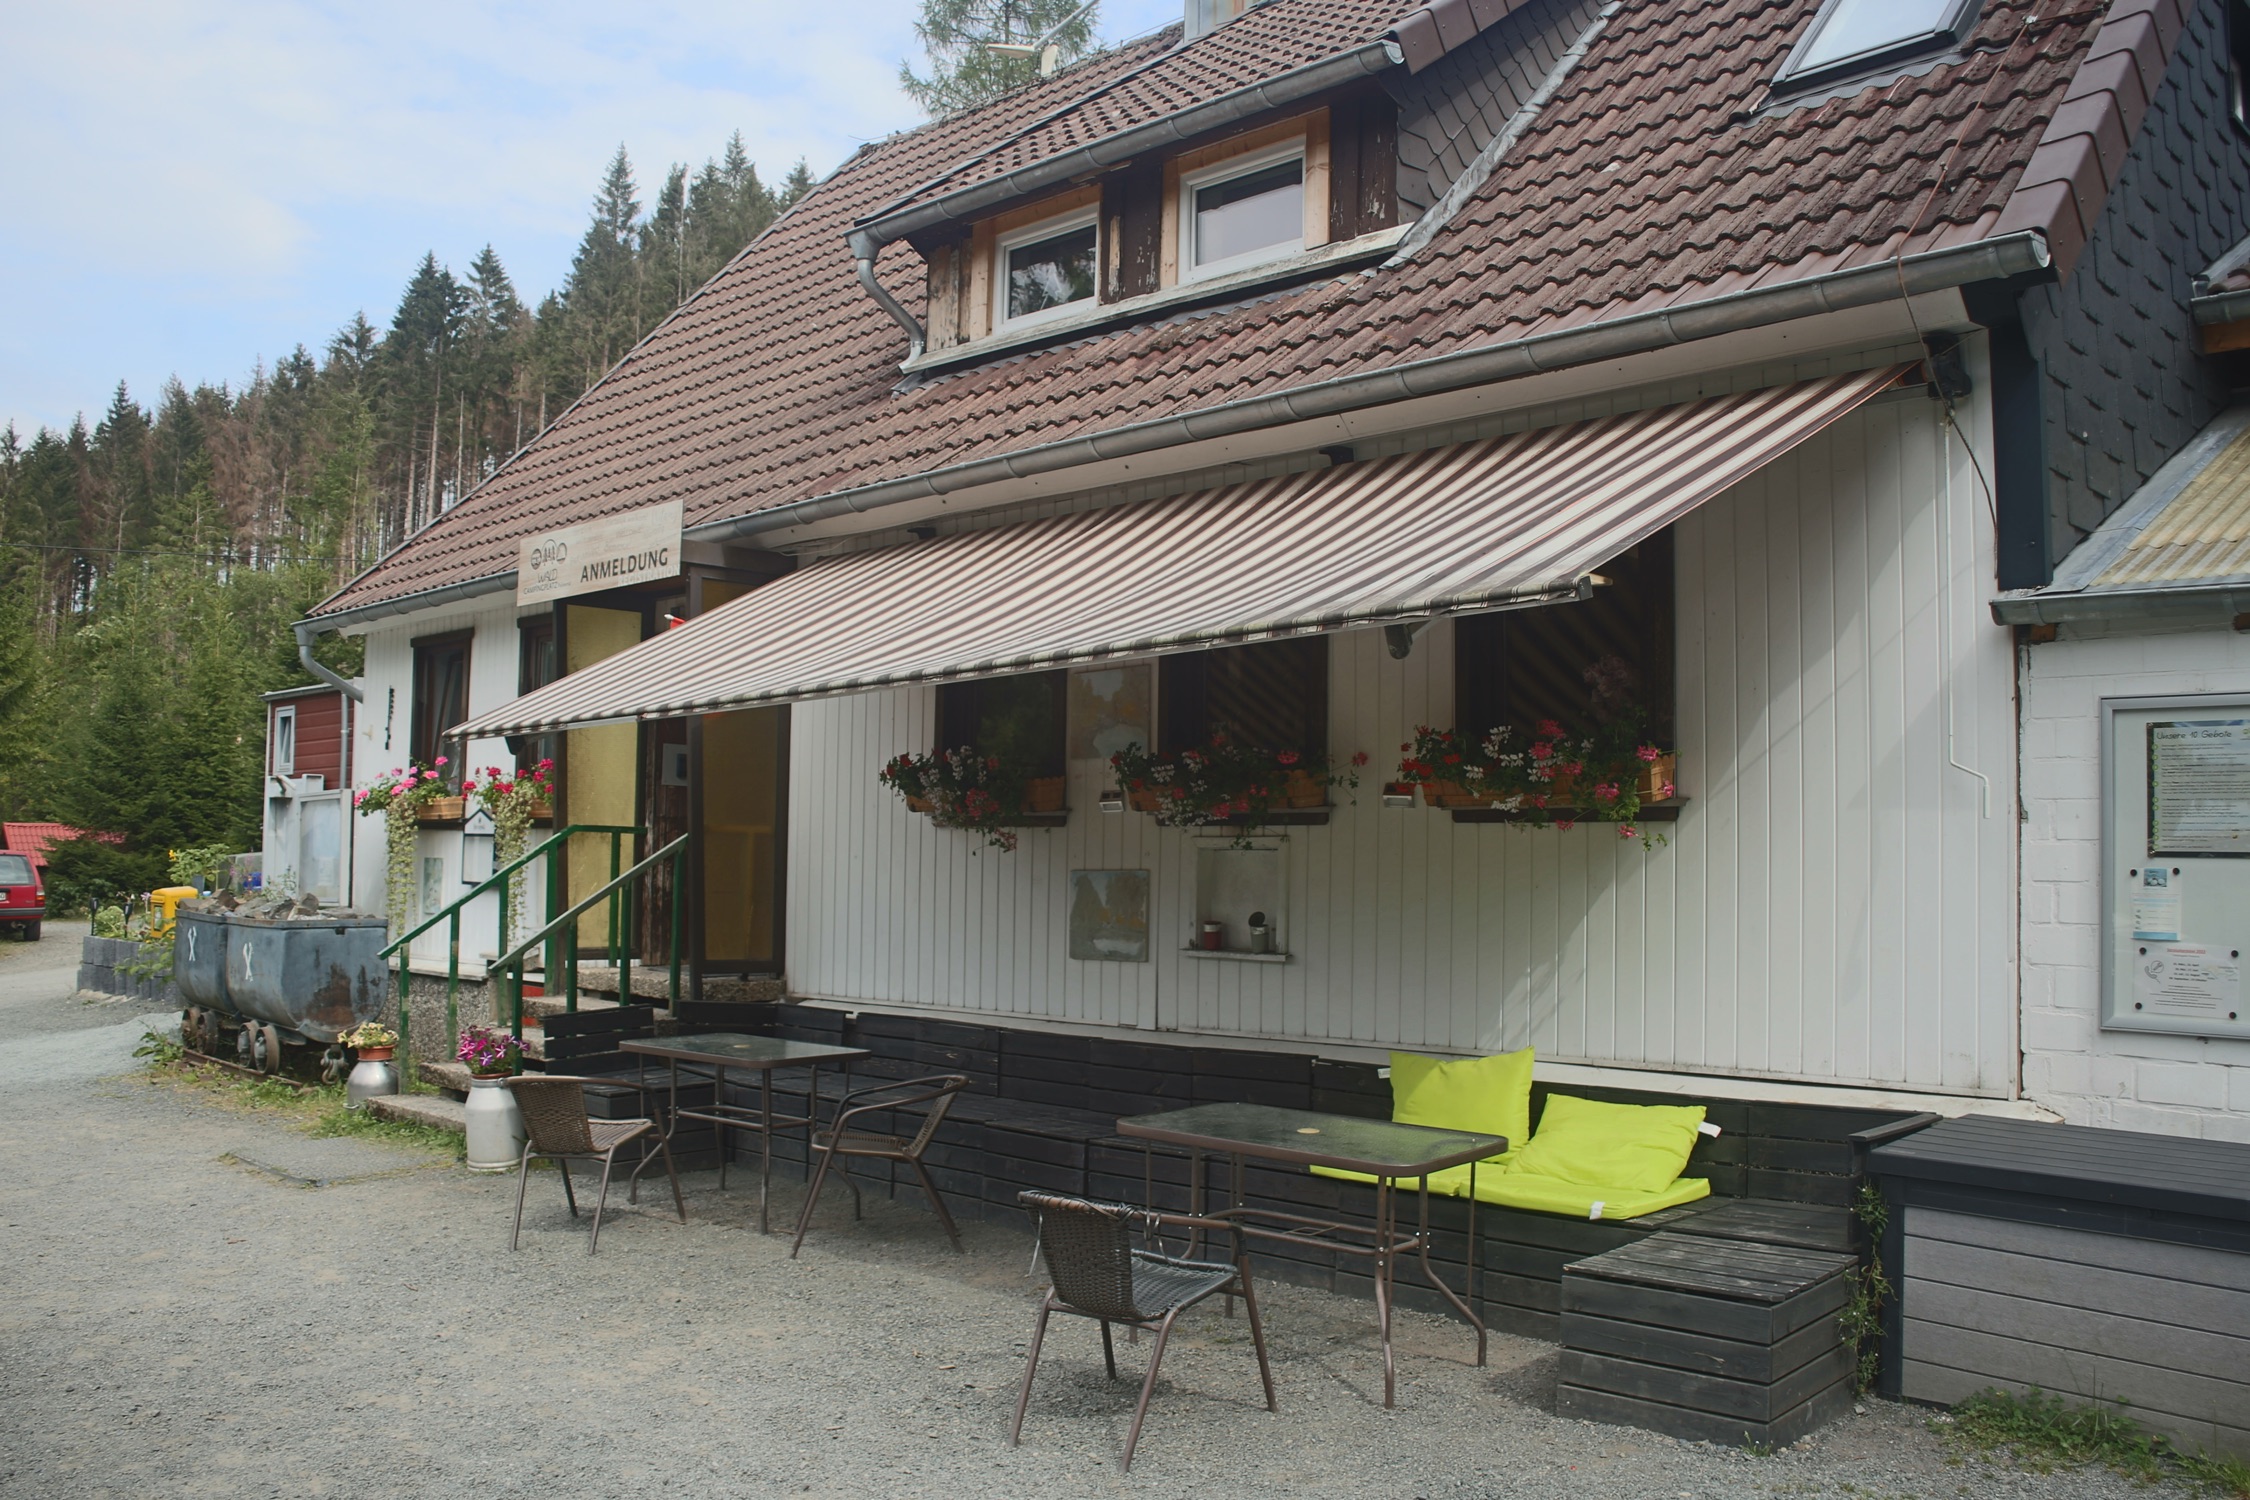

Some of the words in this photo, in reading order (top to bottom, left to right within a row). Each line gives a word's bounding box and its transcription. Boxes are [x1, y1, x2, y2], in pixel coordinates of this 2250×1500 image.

[580, 547, 668, 583] ANMELDUNG
[537, 568, 558, 583] WALD
[618, 564, 680, 585] REGISTRATION
[2156, 732, 2186, 740] Unsere
[2201, 730, 2232, 738] Gebote
